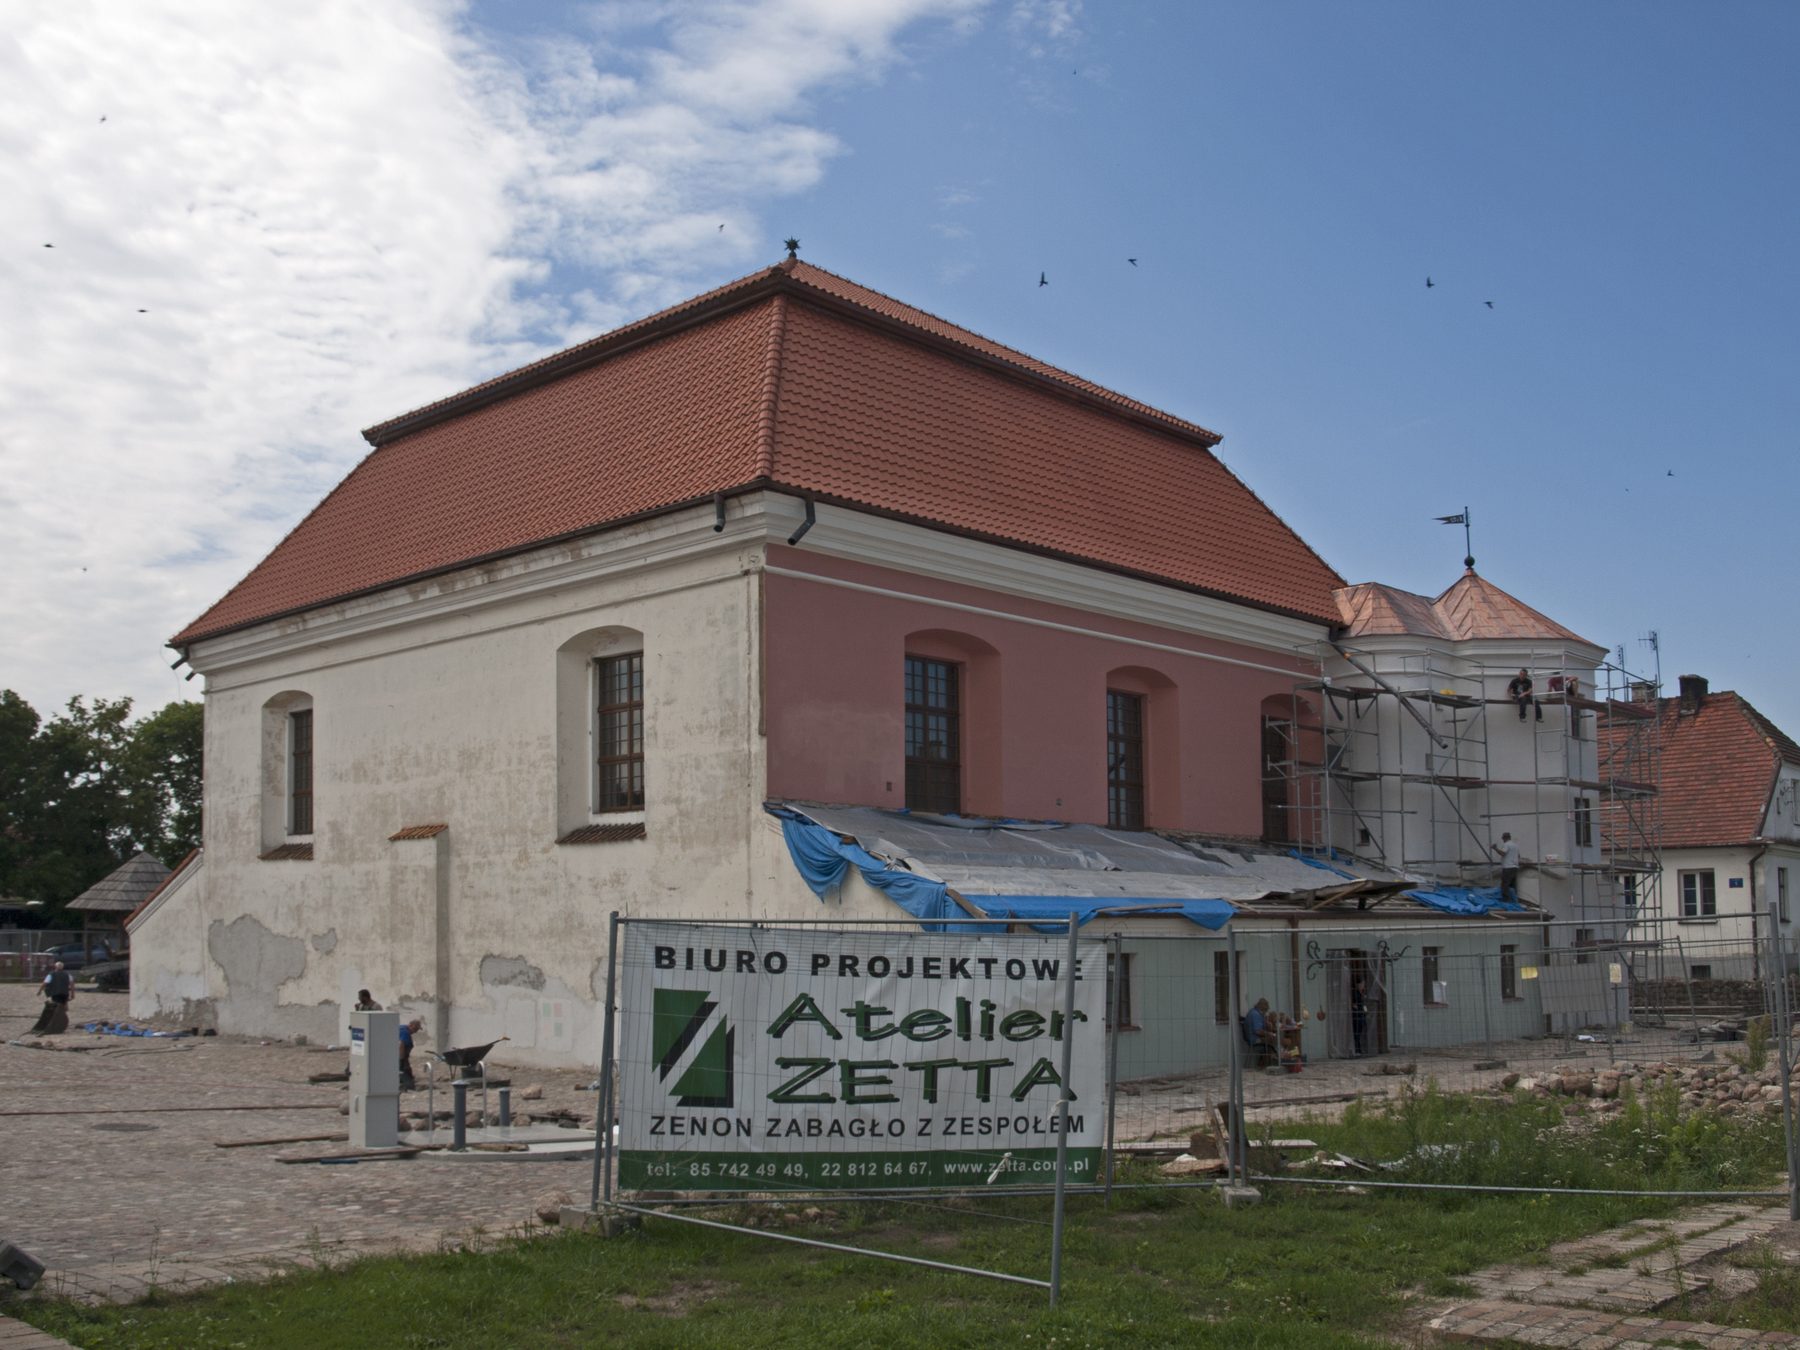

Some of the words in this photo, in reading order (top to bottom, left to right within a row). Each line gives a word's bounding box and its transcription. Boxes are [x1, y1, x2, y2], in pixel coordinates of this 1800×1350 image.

[654, 946, 788, 974] BIURO
[766, 992, 1088, 1042] Atelier
[766, 1057, 1078, 1105] ZETTA
[649, 1116, 752, 1138] ZENON
[766, 1117, 906, 1138] ZABAGŁO
[917, 1118, 932, 1137] Z
[942, 1115, 1085, 1136] ZESPOŁEM
[646, 1162, 677, 1177] tel:
[689, 1162, 711, 1177] 85
[718, 1162, 749, 1177] 742
[756, 1163, 777, 1177] 49
[783, 1163, 809, 1179] 49,
[821, 1162, 841, 1177] 22
[847, 1162, 877, 1177] 812
[883, 1161, 903, 1176] 64
